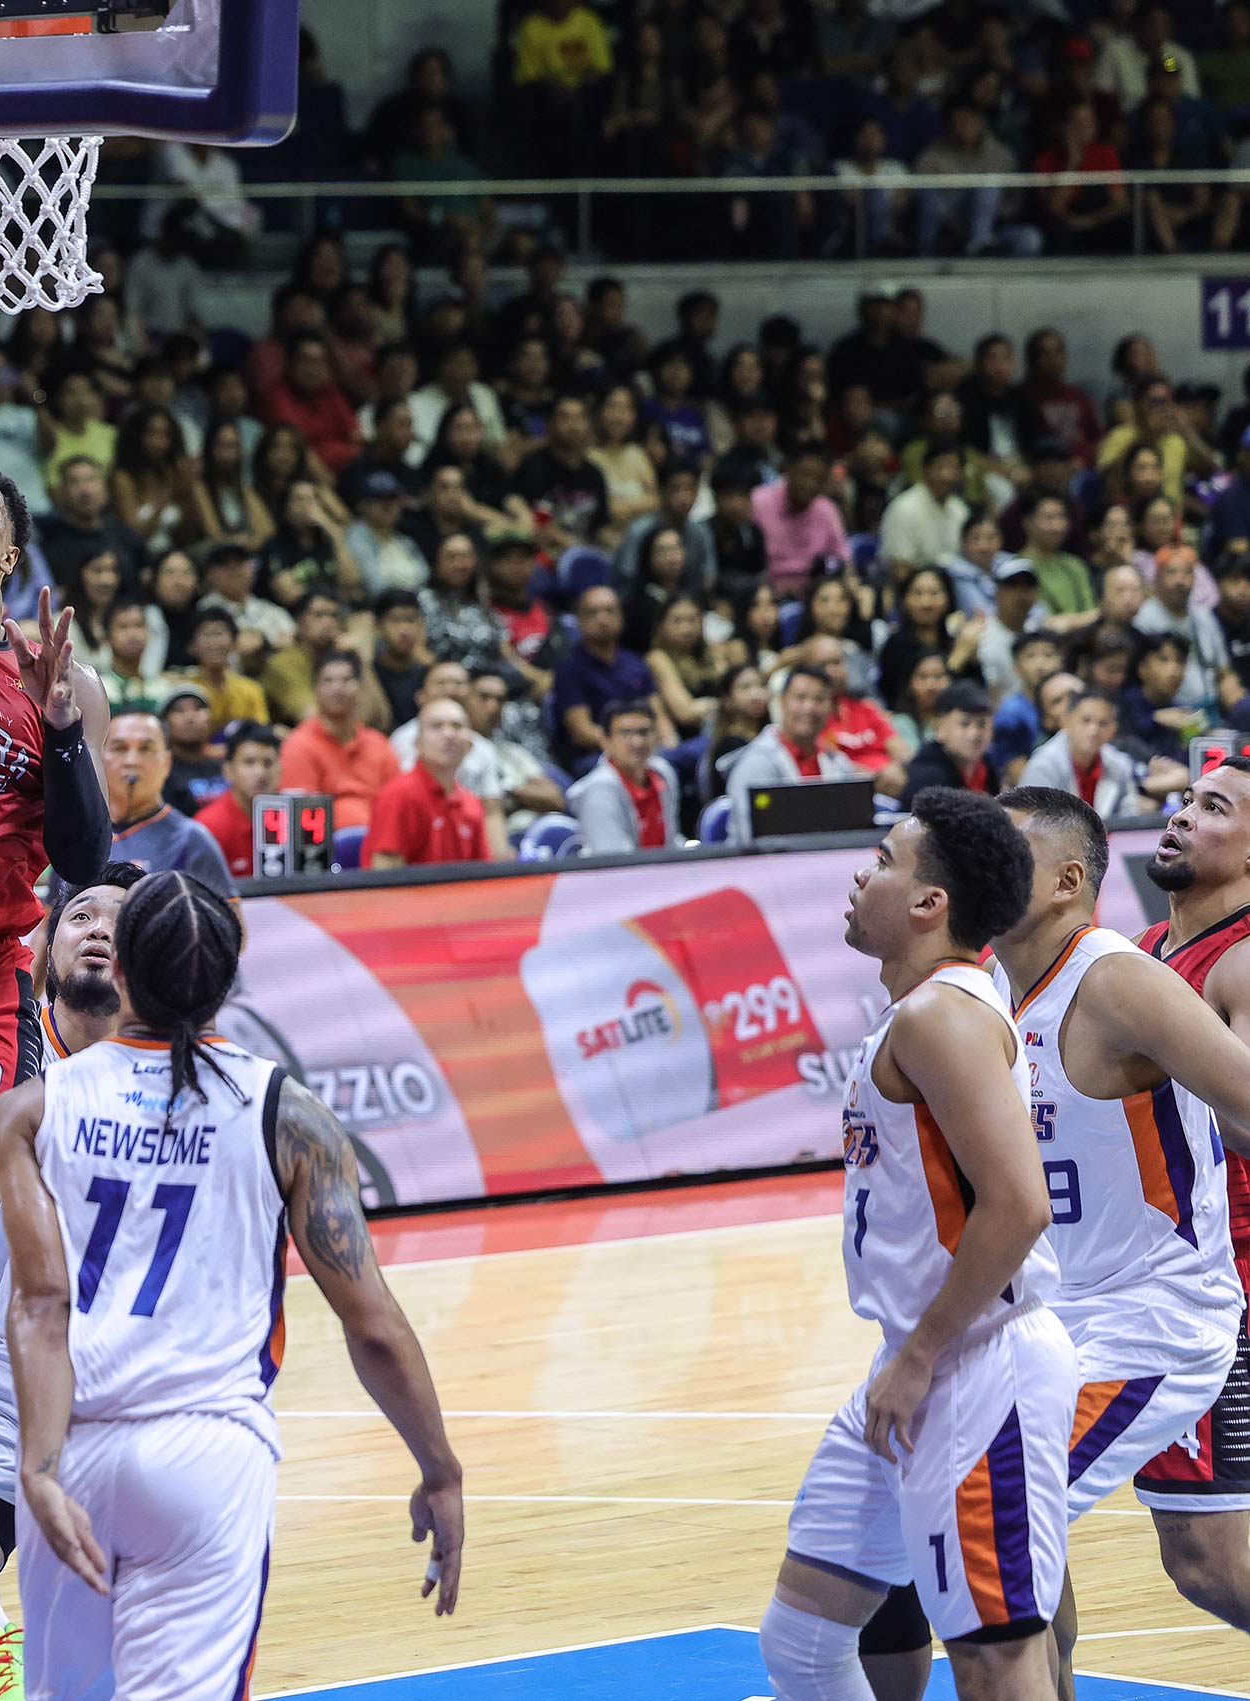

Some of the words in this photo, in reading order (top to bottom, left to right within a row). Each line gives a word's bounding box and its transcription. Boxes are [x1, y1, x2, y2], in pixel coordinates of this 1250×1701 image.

[263, 808, 288, 845] 4
[300, 807, 326, 845] 4
[576, 1006, 671, 1060] SATLITE
[306, 1062, 434, 1122] ZZIO
[73, 1117, 217, 1165] NEWSOME
[77, 1176, 197, 1318] 11
[854, 1188, 870, 1259] 1
[928, 1532, 948, 1593] 1
